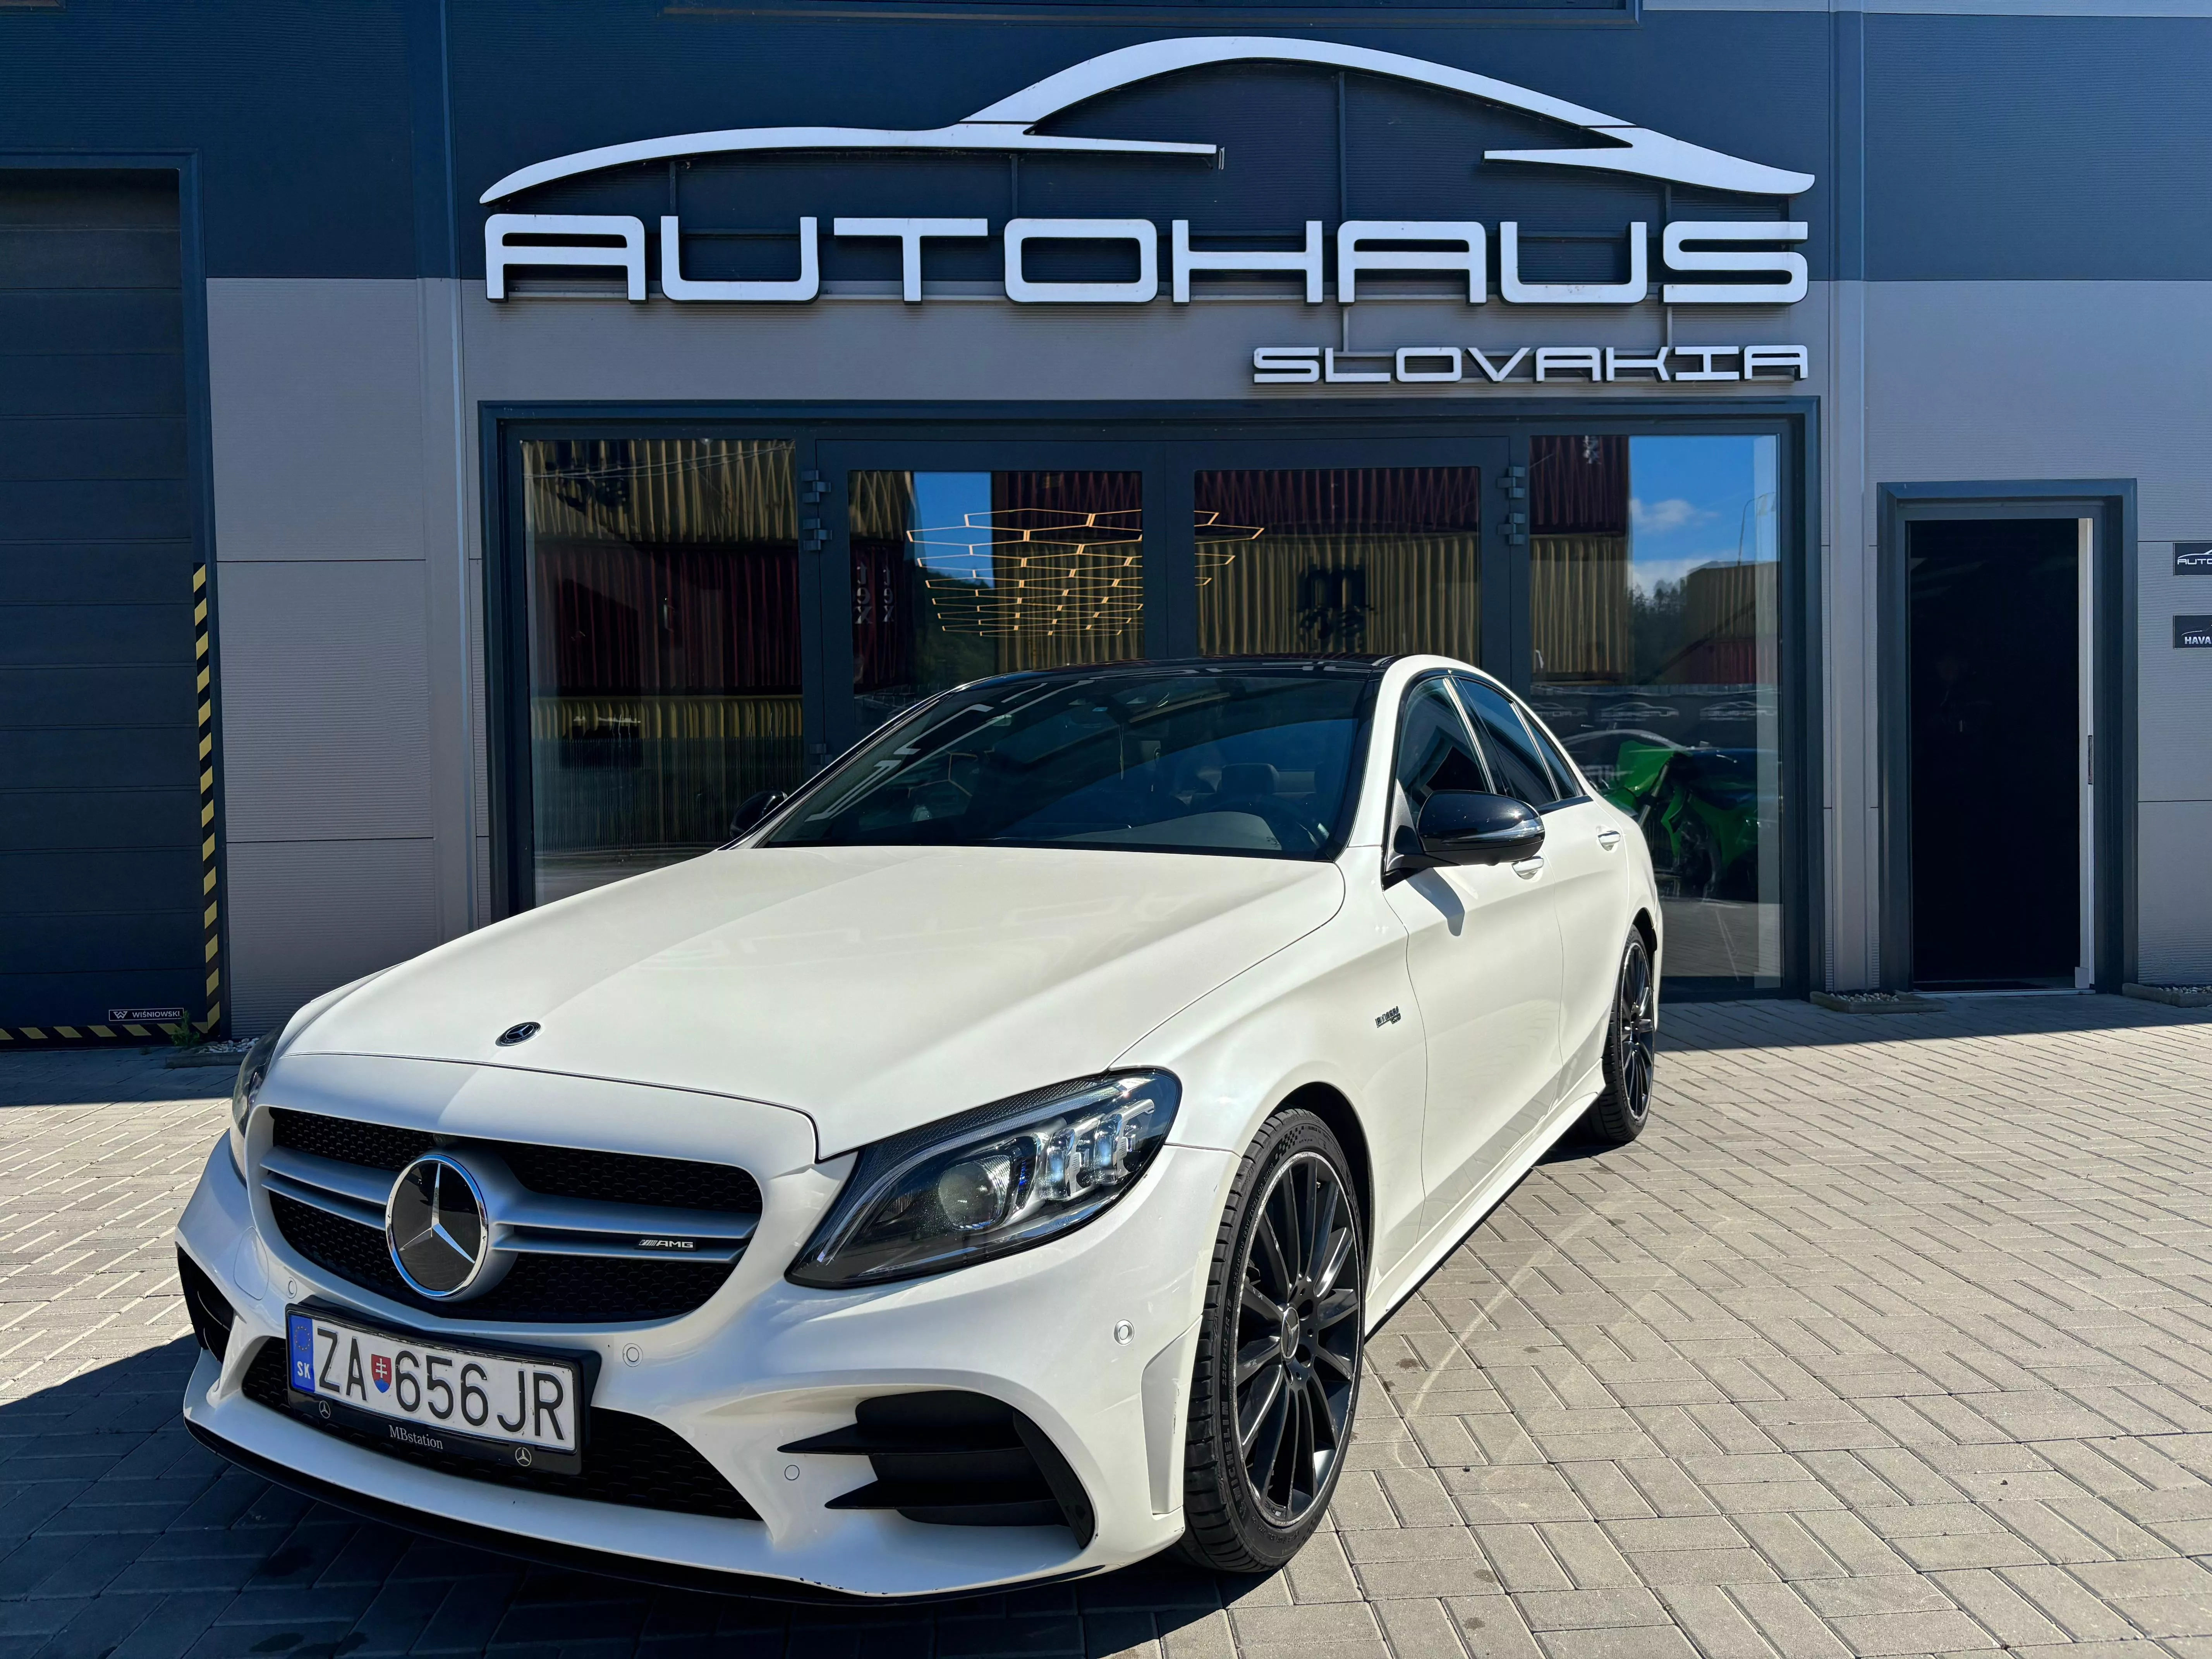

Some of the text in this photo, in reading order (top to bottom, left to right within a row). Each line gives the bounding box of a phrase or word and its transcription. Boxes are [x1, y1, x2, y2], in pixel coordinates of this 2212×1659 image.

[484, 213, 1809, 305] AUTOHAUS
[1252, 345, 1809, 384] SLOVAKIA
[2184, 636, 2212, 644] HAVA
[656, 1240, 693, 1248] AMG
[297, 1361, 311, 1379] SK
[317, 1328, 367, 1401] ZA
[390, 1425, 443, 1449] MBstation
[1221, 1401, 1242, 1501] MICHELIN
